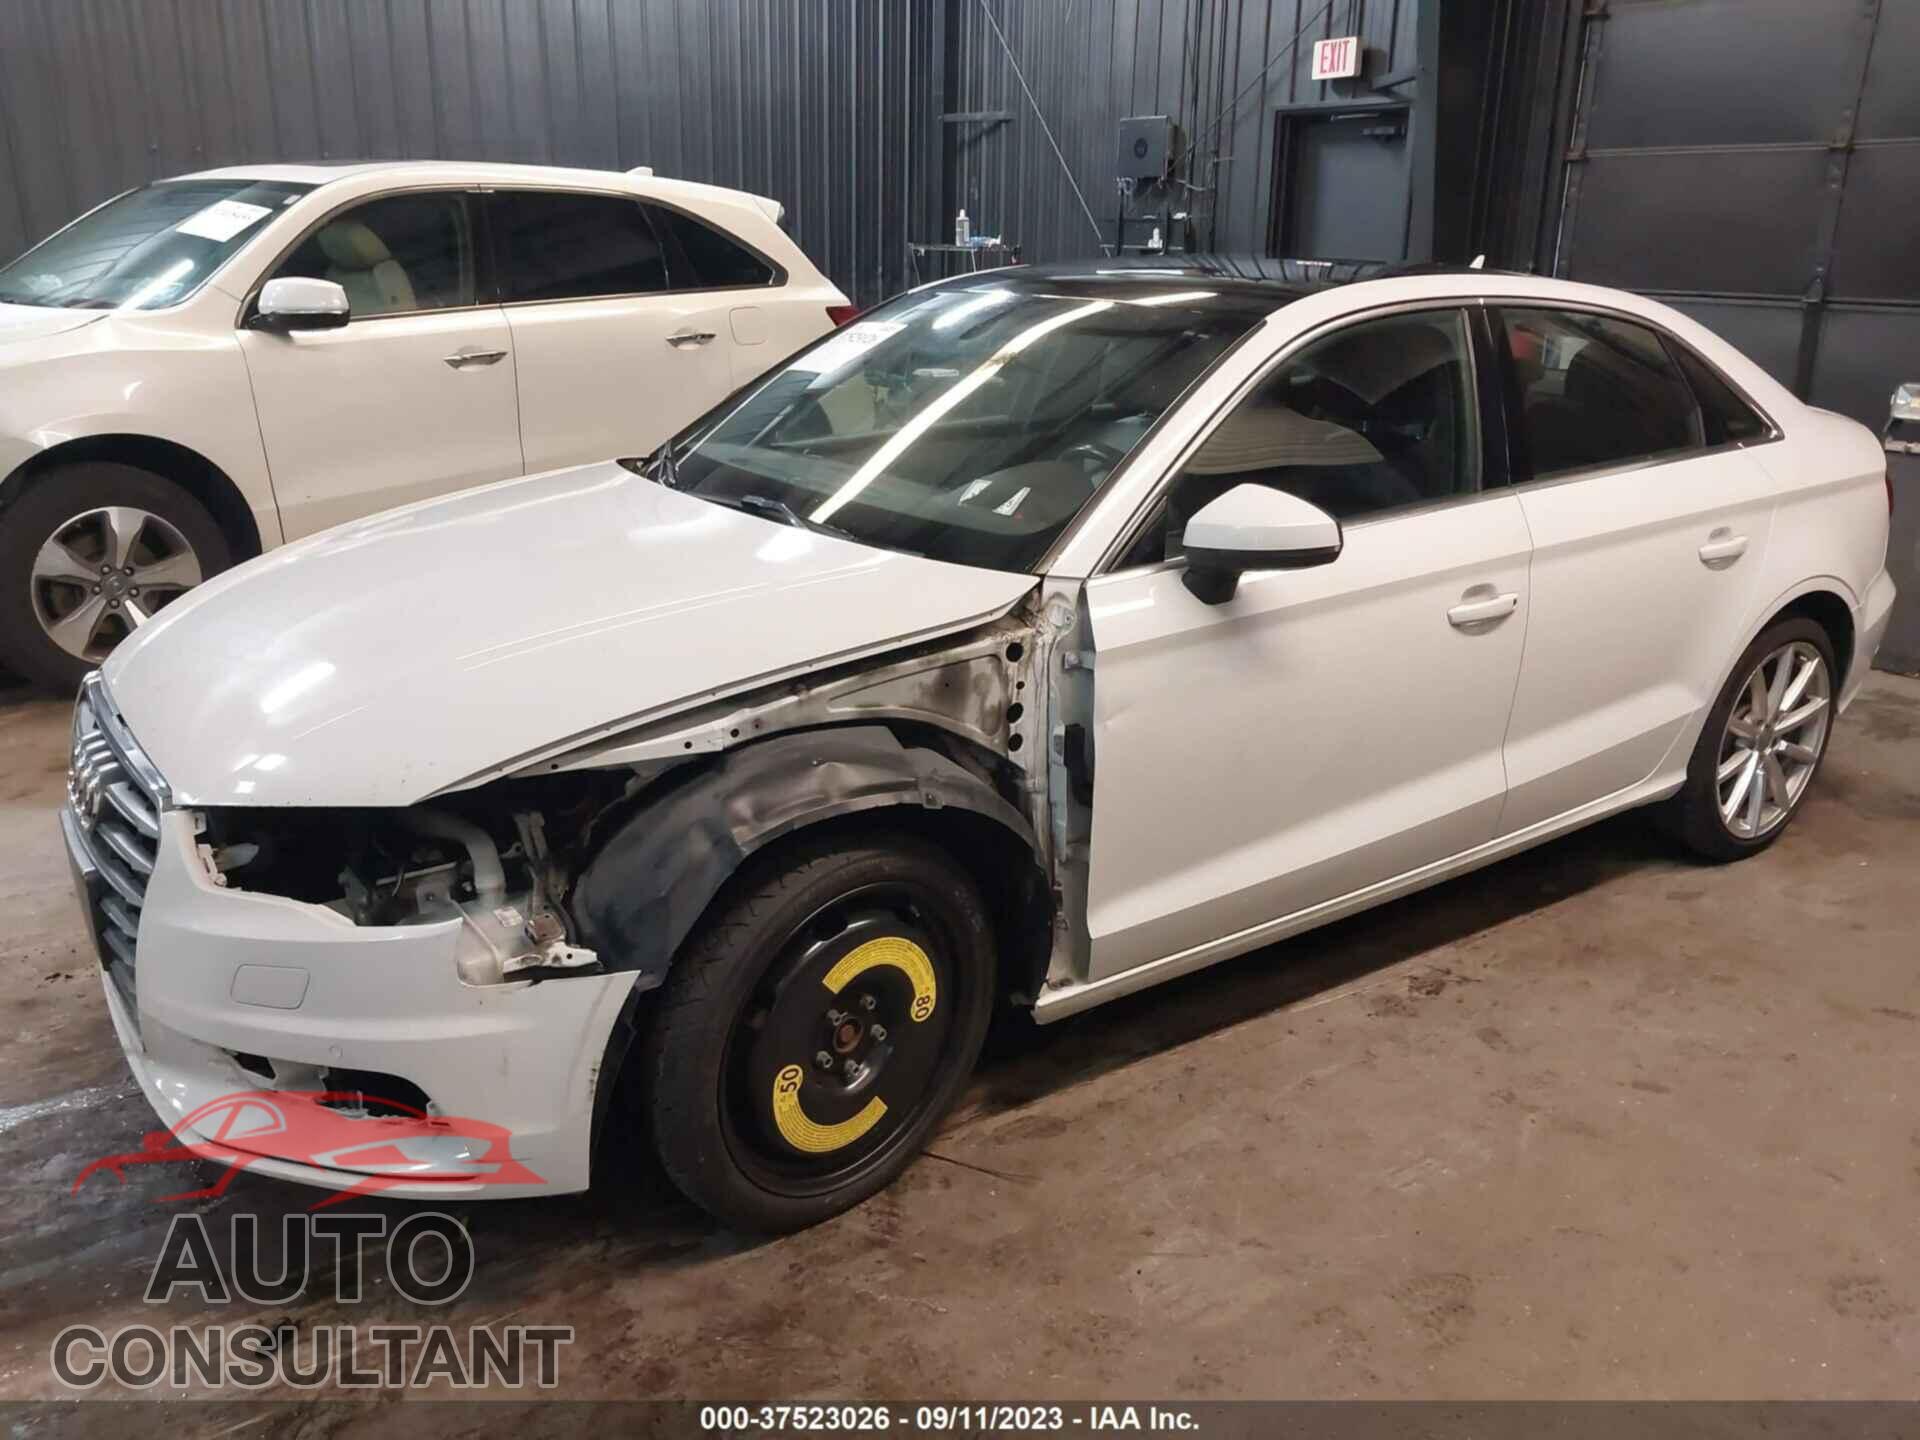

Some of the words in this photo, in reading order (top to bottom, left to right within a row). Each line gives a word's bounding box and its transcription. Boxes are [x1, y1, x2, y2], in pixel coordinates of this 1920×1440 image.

[1320, 40, 1350, 74] EXIT
[915, 994, 930, 1020] 80
[780, 1067, 799, 1094] 50
